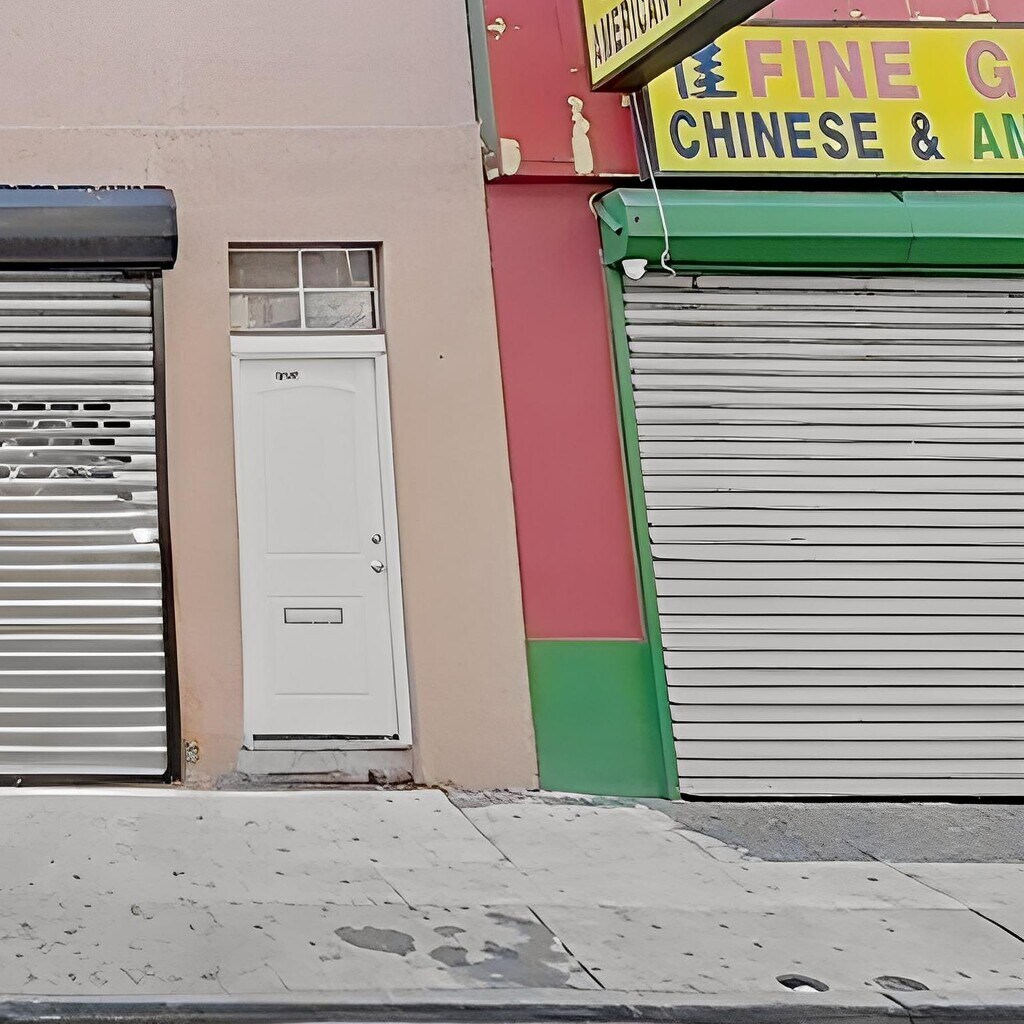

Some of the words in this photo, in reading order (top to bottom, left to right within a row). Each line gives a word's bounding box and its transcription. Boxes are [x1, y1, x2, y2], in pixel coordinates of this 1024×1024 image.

[744, 39, 920, 99] FINE
[670, 109, 885, 160] CHINESE
[911, 111, 946, 161] &
